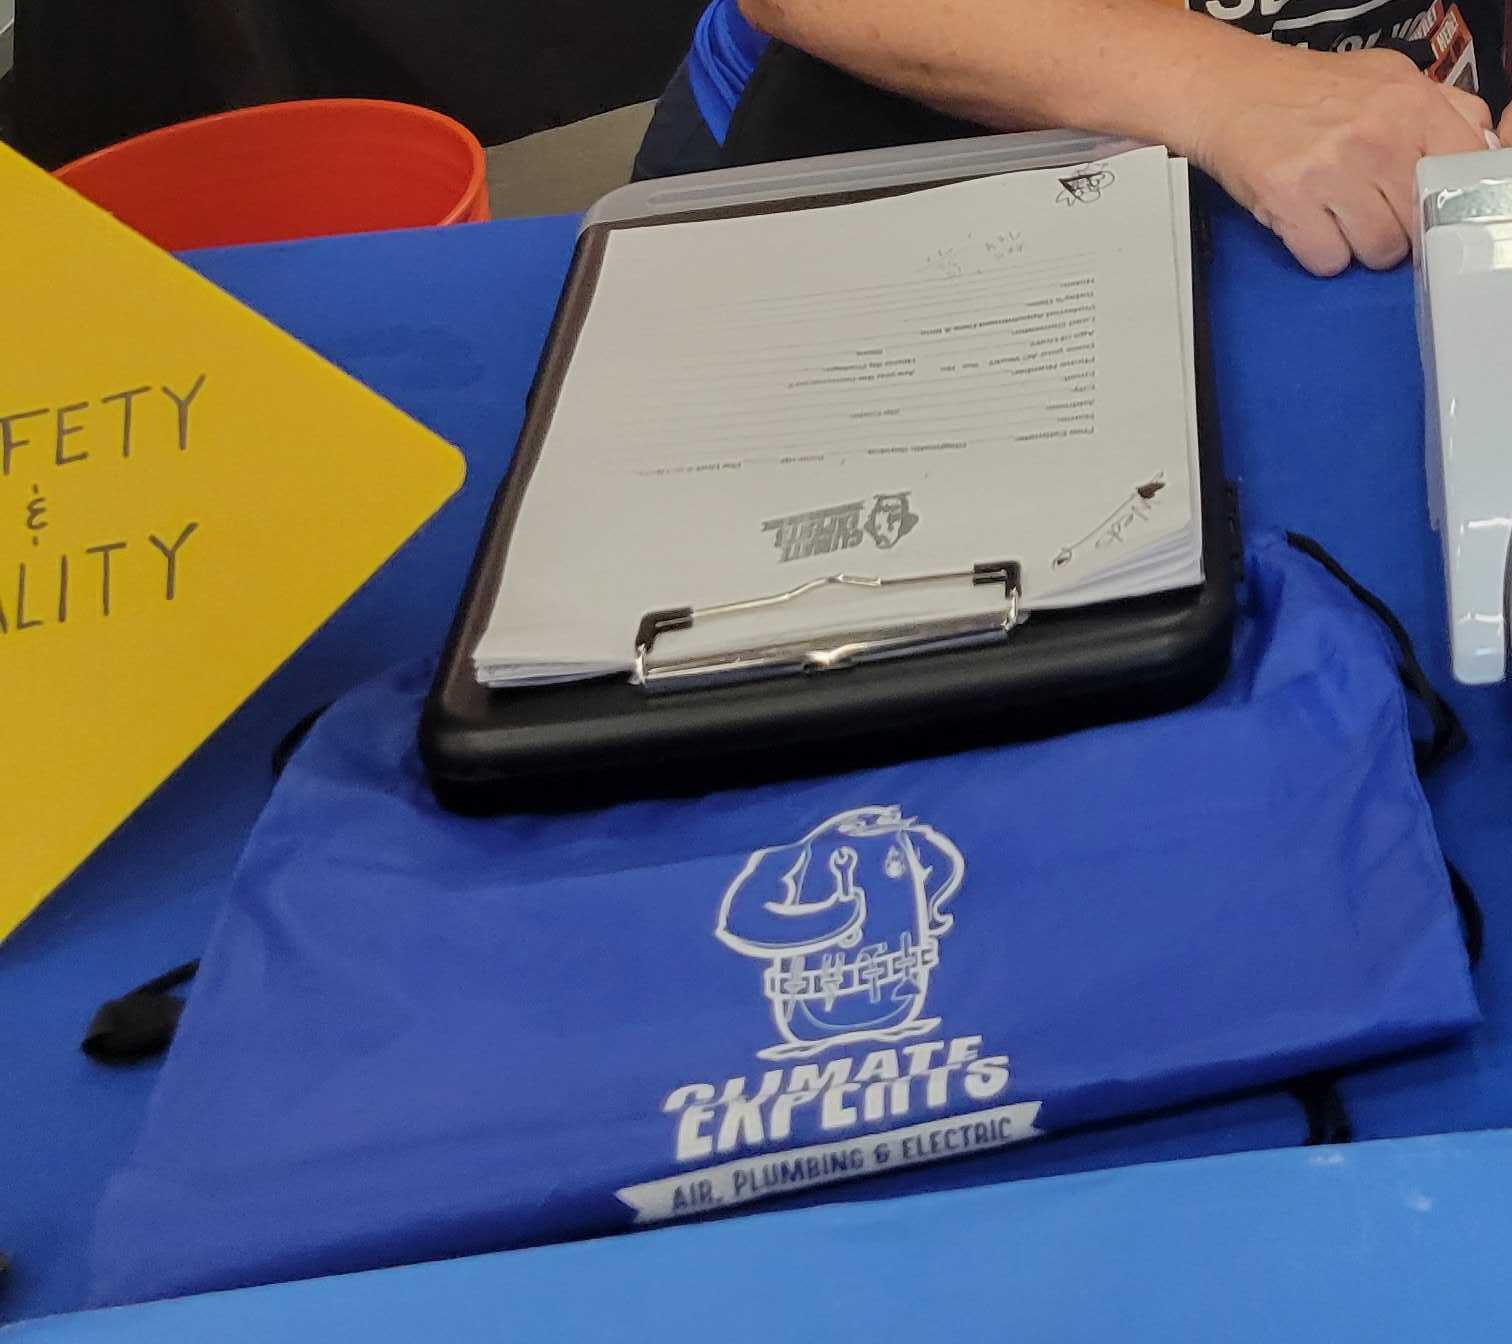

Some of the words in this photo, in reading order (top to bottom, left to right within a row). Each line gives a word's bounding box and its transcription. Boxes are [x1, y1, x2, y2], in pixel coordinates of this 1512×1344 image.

[0, 374, 207, 475] FETY
[0, 522, 200, 635] LITY
[663, 1034, 984, 1113] CLIMATE
[676, 1055, 1010, 1161] EXPERTS
[733, 1143, 865, 1196] PLUMBING
[901, 1116, 1014, 1163] ELECTRIC
